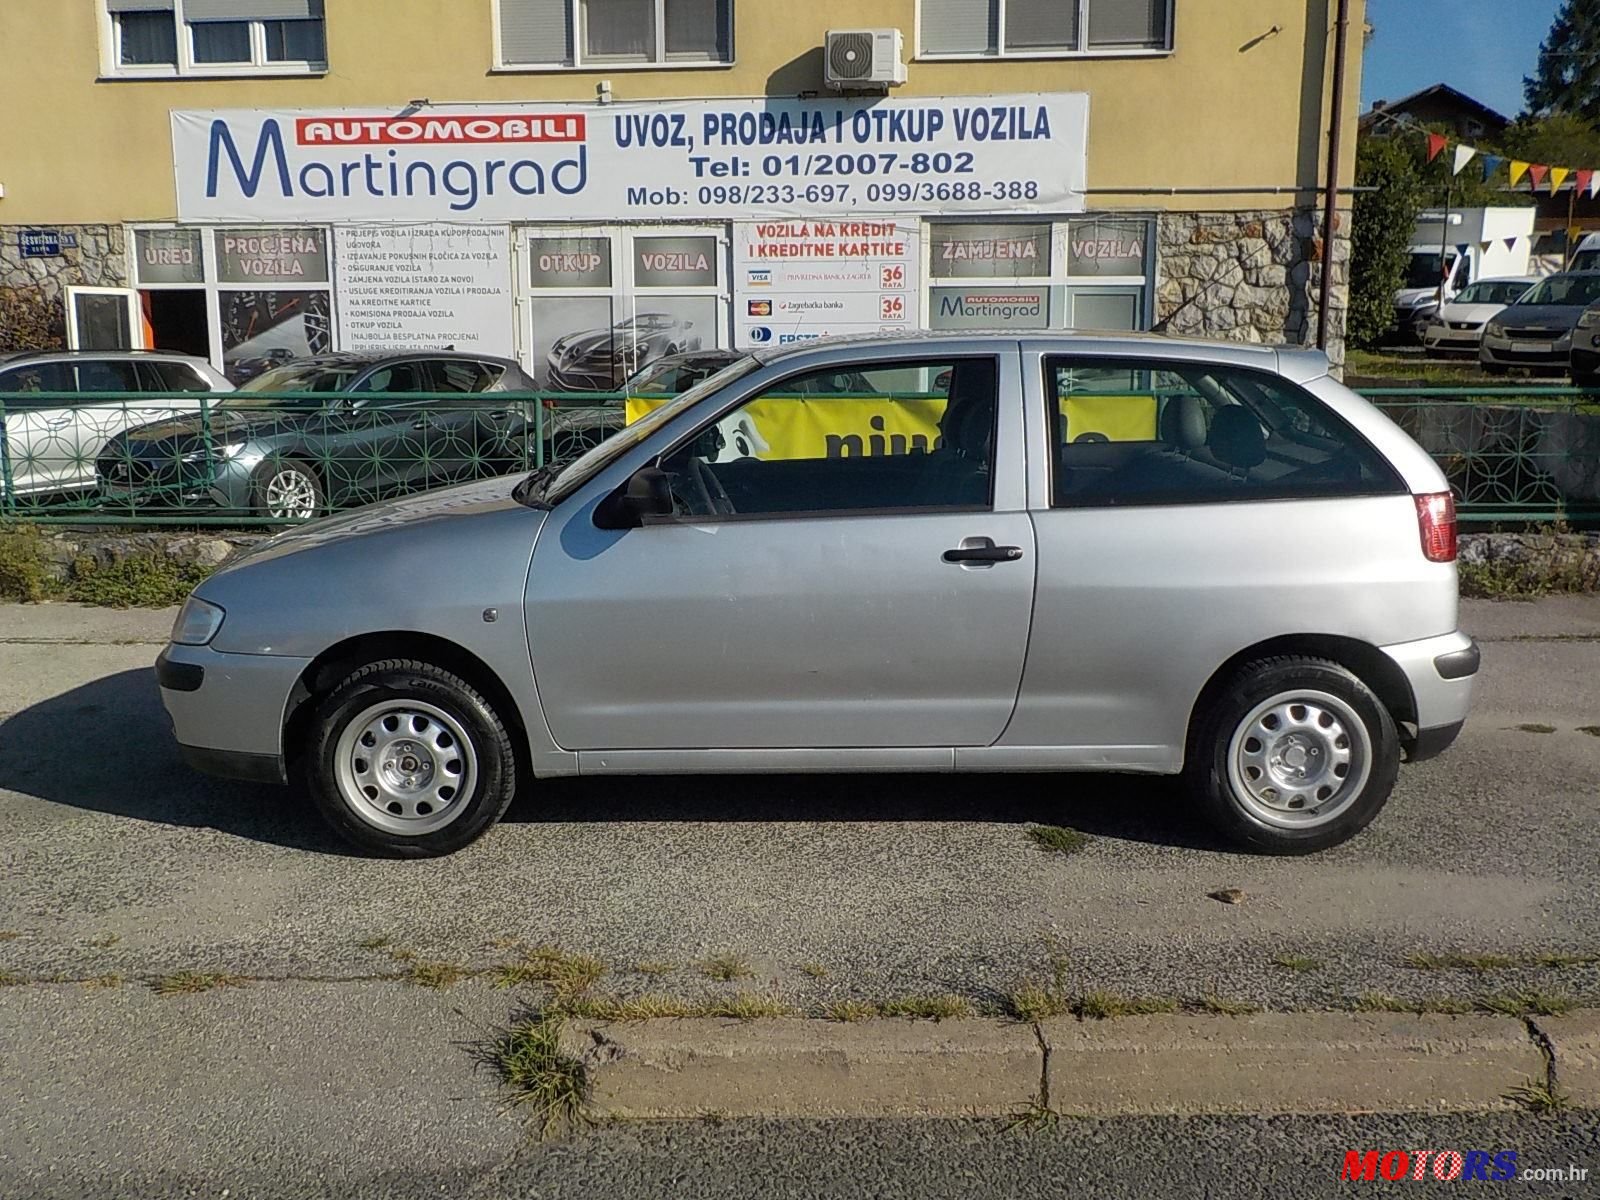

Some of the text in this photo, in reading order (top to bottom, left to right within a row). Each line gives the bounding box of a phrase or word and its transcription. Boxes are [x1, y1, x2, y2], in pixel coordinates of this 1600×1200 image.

[304, 119, 577, 141] AUTOMOBILI
[615, 106, 1051, 153] UVOZ, PRODAJA I OTKUP VOZILA
[206, 118, 587, 211] Martingrad
[689, 152, 975, 178] Tel: 01/2007-802
[626, 181, 1038, 206] Mob: 098/233-697, 099/3688-388
[381, 229, 406, 237] VOZILA
[756, 223, 896, 238] VOZILA NA KREDIT
[224, 237, 317, 255] PROCJENA
[346, 241, 381, 249] UGOVORA
[750, 243, 904, 258] I KREDITNE KARTICE
[942, 240, 1038, 260] ZAMJENA
[1072, 240, 1143, 259] VOZILA
[145, 249, 193, 265] URED
[347, 252, 387, 260] IZDAVANJE
[461, 252, 470, 260] ZA
[472, 252, 498, 260] VOZILA
[539, 254, 601, 272] OTKUP
[641, 254, 709, 271] VOZILA
[240, 259, 304, 276] VOZILA
[347, 264, 422, 272] OSIGURANJE VOZILA
[883, 266, 902, 282] 36
[348, 275, 383, 283] ZAMJENA
[384, 275, 410, 283] VOZILA
[440, 275, 449, 283] ZA
[349, 287, 378, 295] USLUGE
[380, 287, 433, 295] KREDITIRANJA
[435, 287, 461, 295] VOZILA
[467, 287, 501, 295] PRODAJA
[349, 298, 431, 306] NA KREDITNE KARTICE
[823, 301, 843, 309] banka
[883, 297, 902, 313] 36
[940, 296, 1040, 319] Martingrad
[350, 310, 454, 318] KOMISIONA PRODAJA VOZILA
[351, 321, 402, 329] OTKUP VOZILA
[393, 332, 436, 340] BESPLATNA
